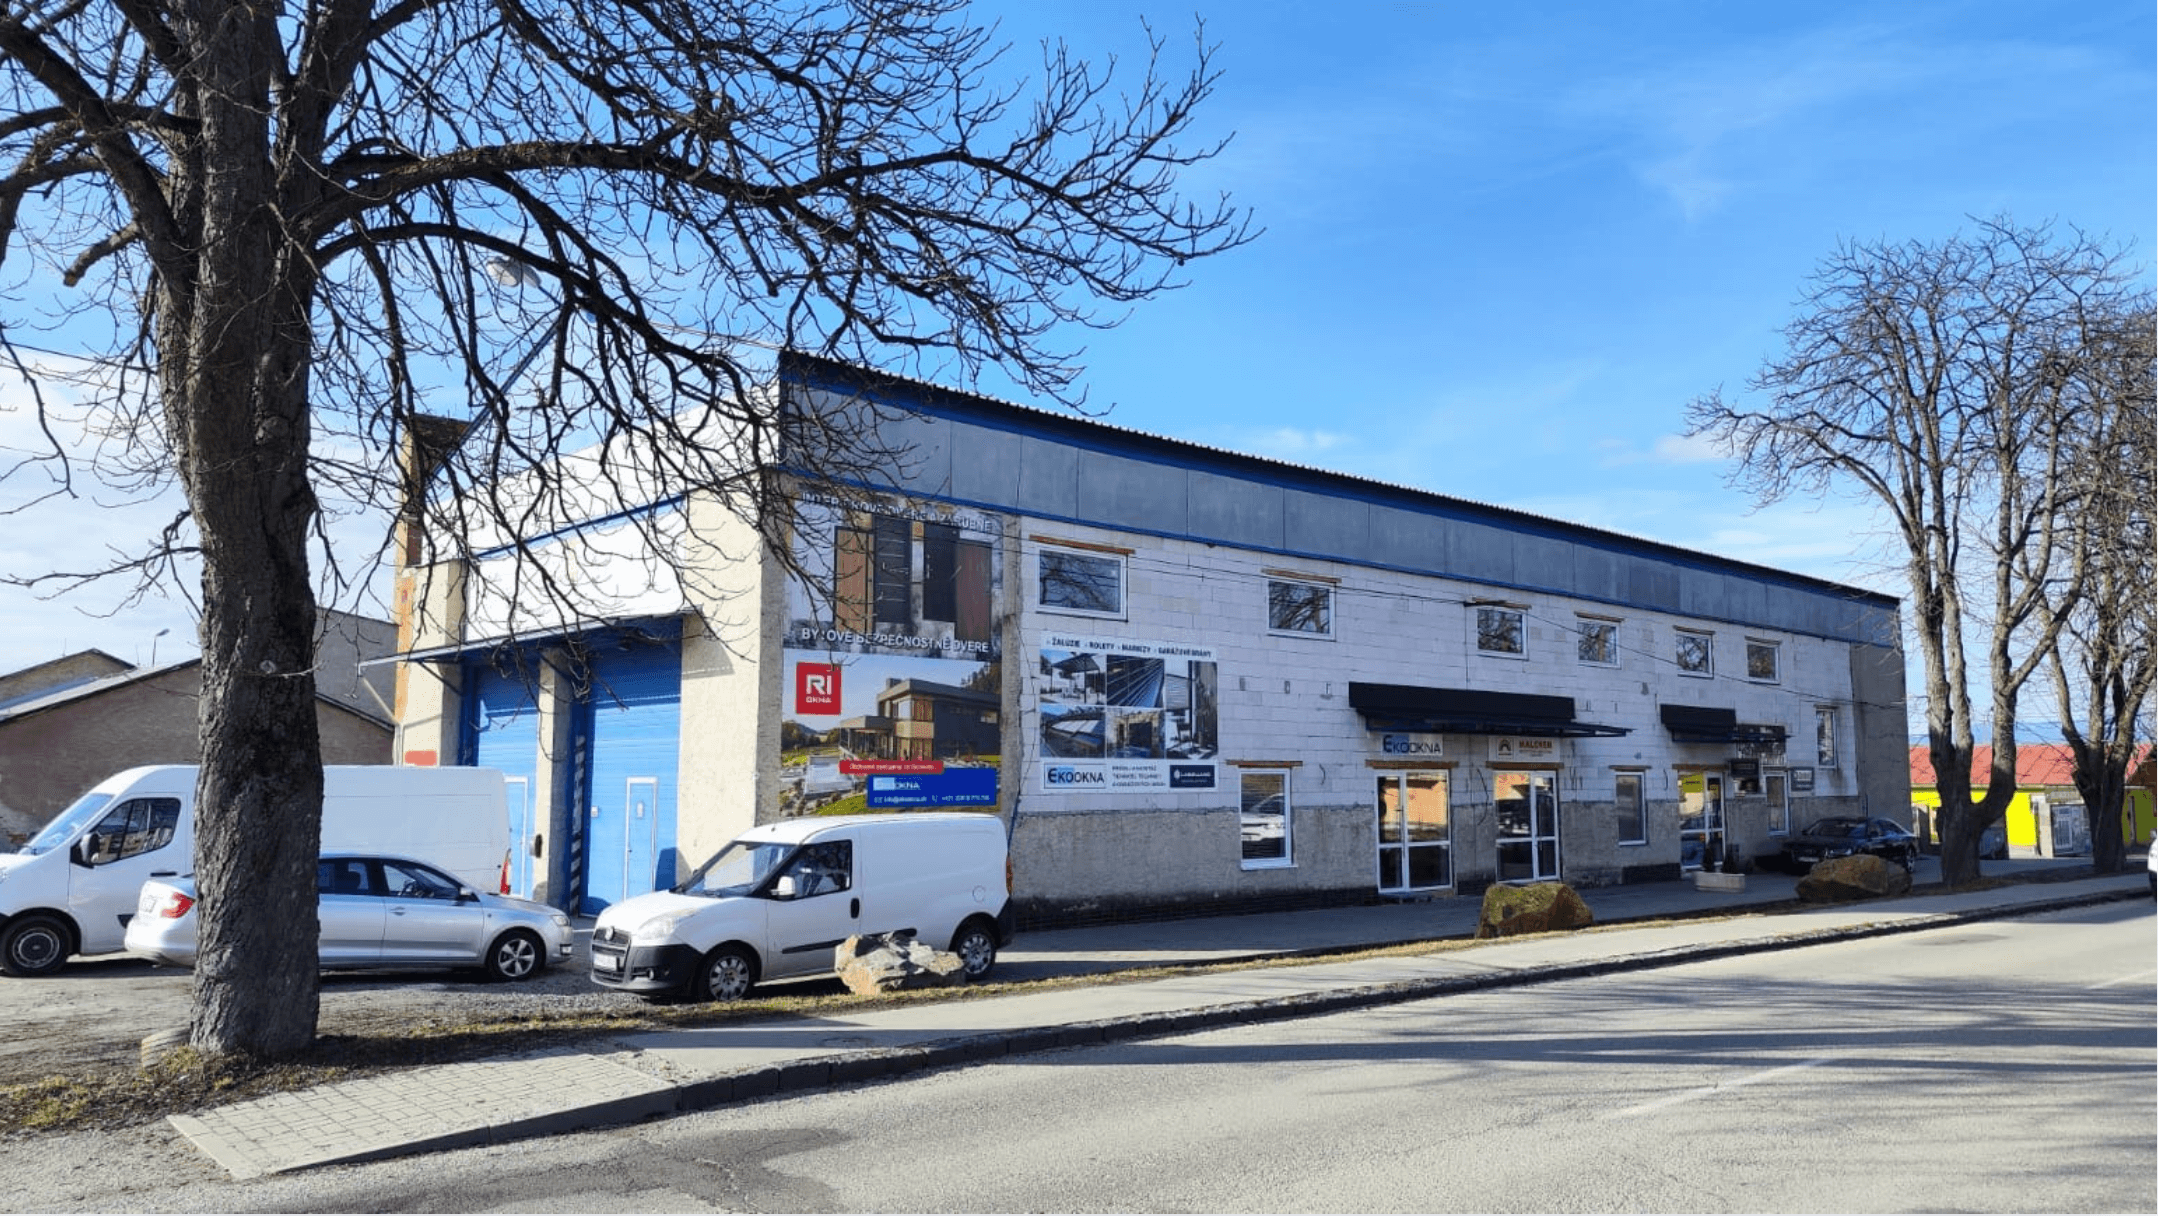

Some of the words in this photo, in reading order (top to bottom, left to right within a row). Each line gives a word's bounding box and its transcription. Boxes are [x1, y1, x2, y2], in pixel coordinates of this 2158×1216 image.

[802, 627, 853, 643] BYOVÉ
[954, 639, 989, 653] DVERE
[806, 696, 832, 704] OKNA
[1047, 767, 1105, 784] EKOOKNA
